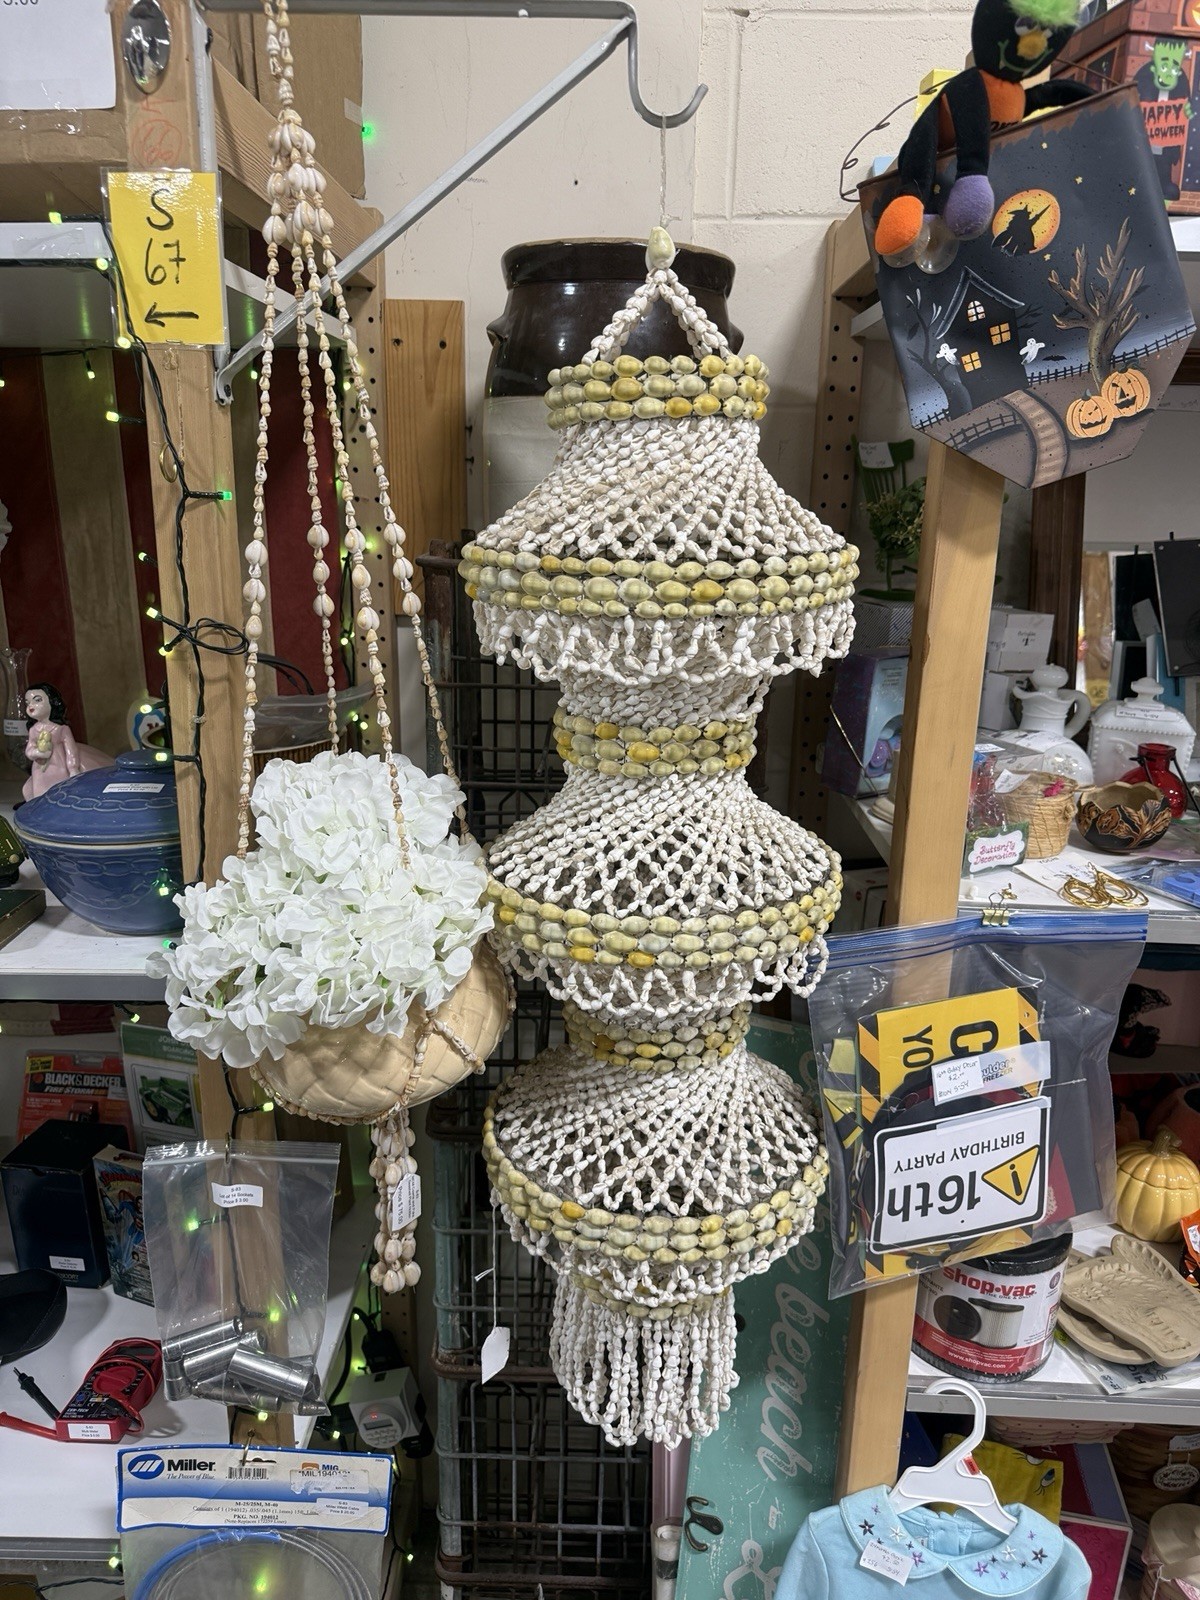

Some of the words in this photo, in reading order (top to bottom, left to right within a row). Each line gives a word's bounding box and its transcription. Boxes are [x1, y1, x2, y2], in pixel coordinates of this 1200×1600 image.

[146, 188, 174, 231] S
[145, 238, 187, 285] 67
[973, 851, 1018, 866] Decoration
[979, 840, 1016, 855] Butterfly
[950, 1131, 1025, 1162] BIRTHDAY
[894, 1151, 945, 1174] PARTY
[887, 1170, 982, 1223] 16th
[948, 1350, 1006, 1369] www.shopvac.com
[757, 1282, 831, 1482] beach
[167, 1459, 216, 1471] Miller
